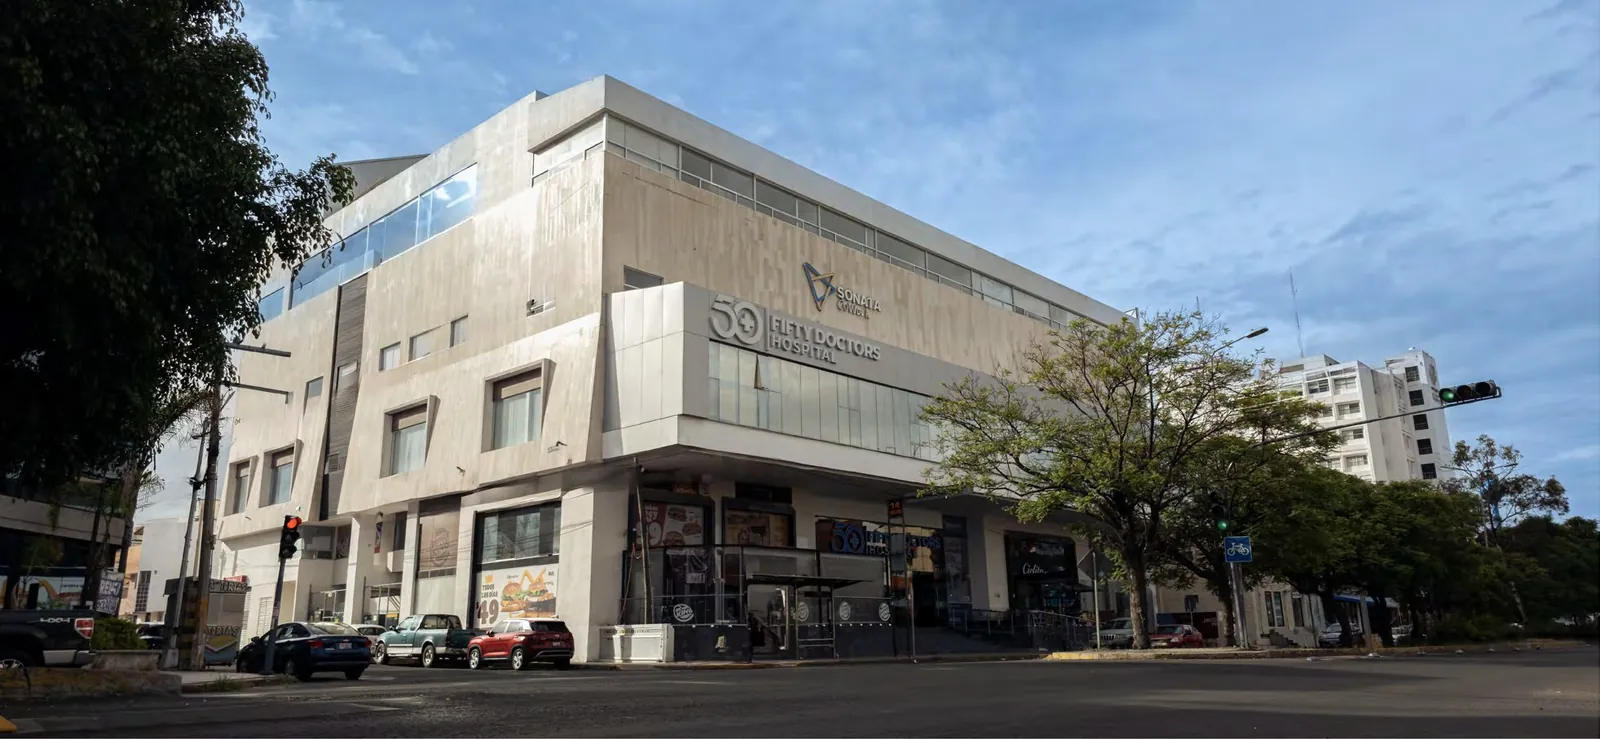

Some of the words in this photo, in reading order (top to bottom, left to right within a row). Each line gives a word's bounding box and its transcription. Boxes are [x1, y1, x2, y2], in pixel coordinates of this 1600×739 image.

[836, 286, 882, 312] SONATA
[709, 293, 764, 345] 50
[770, 315, 814, 342] FIFTY
[815, 329, 881, 361] DOCTORS
[771, 333, 837, 364] HOSPITAL
